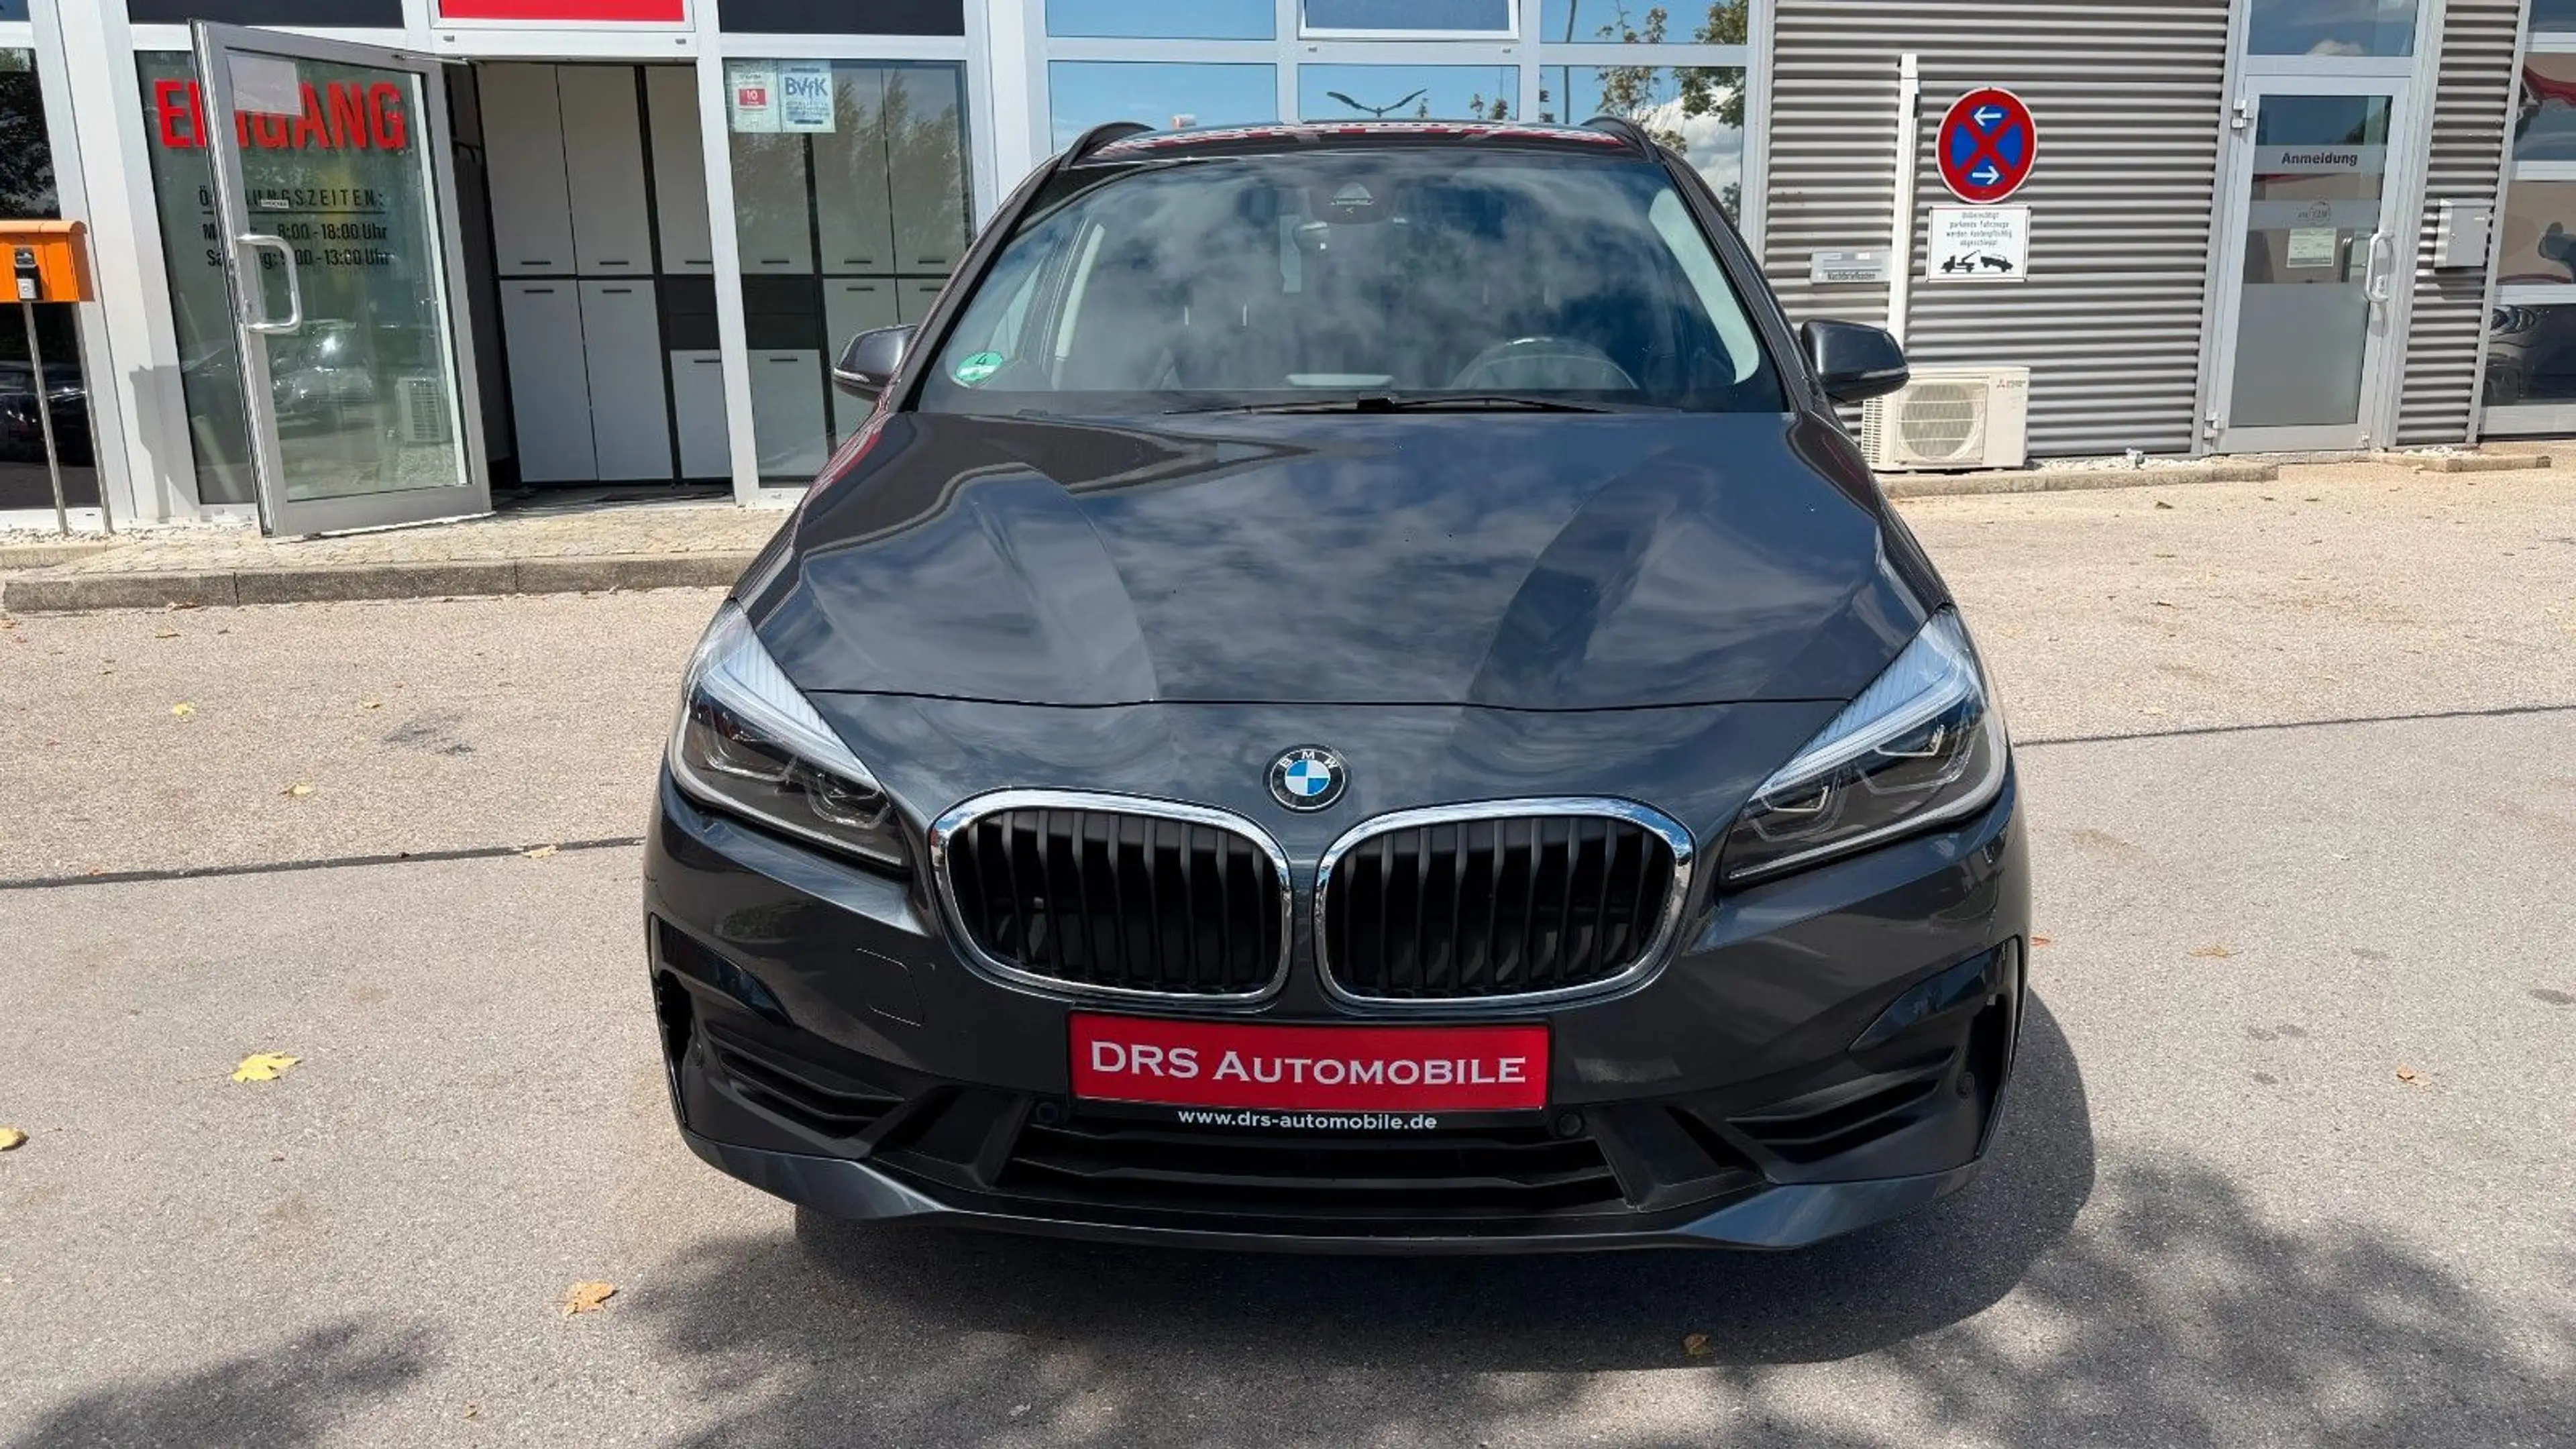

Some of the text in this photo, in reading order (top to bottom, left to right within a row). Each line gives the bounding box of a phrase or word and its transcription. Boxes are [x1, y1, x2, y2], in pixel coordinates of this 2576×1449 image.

[154, 78, 406, 149] EIGANG
[2282, 153, 2358, 166] Anmeldung
[364, 223, 387, 239] Uhr
[975, 354, 987, 366] 4
[1279, 751, 1340, 769] BMW
[1091, 1040, 1199, 1080] DRS
[1178, 1110, 1438, 1130] www.drs-automobile.de
